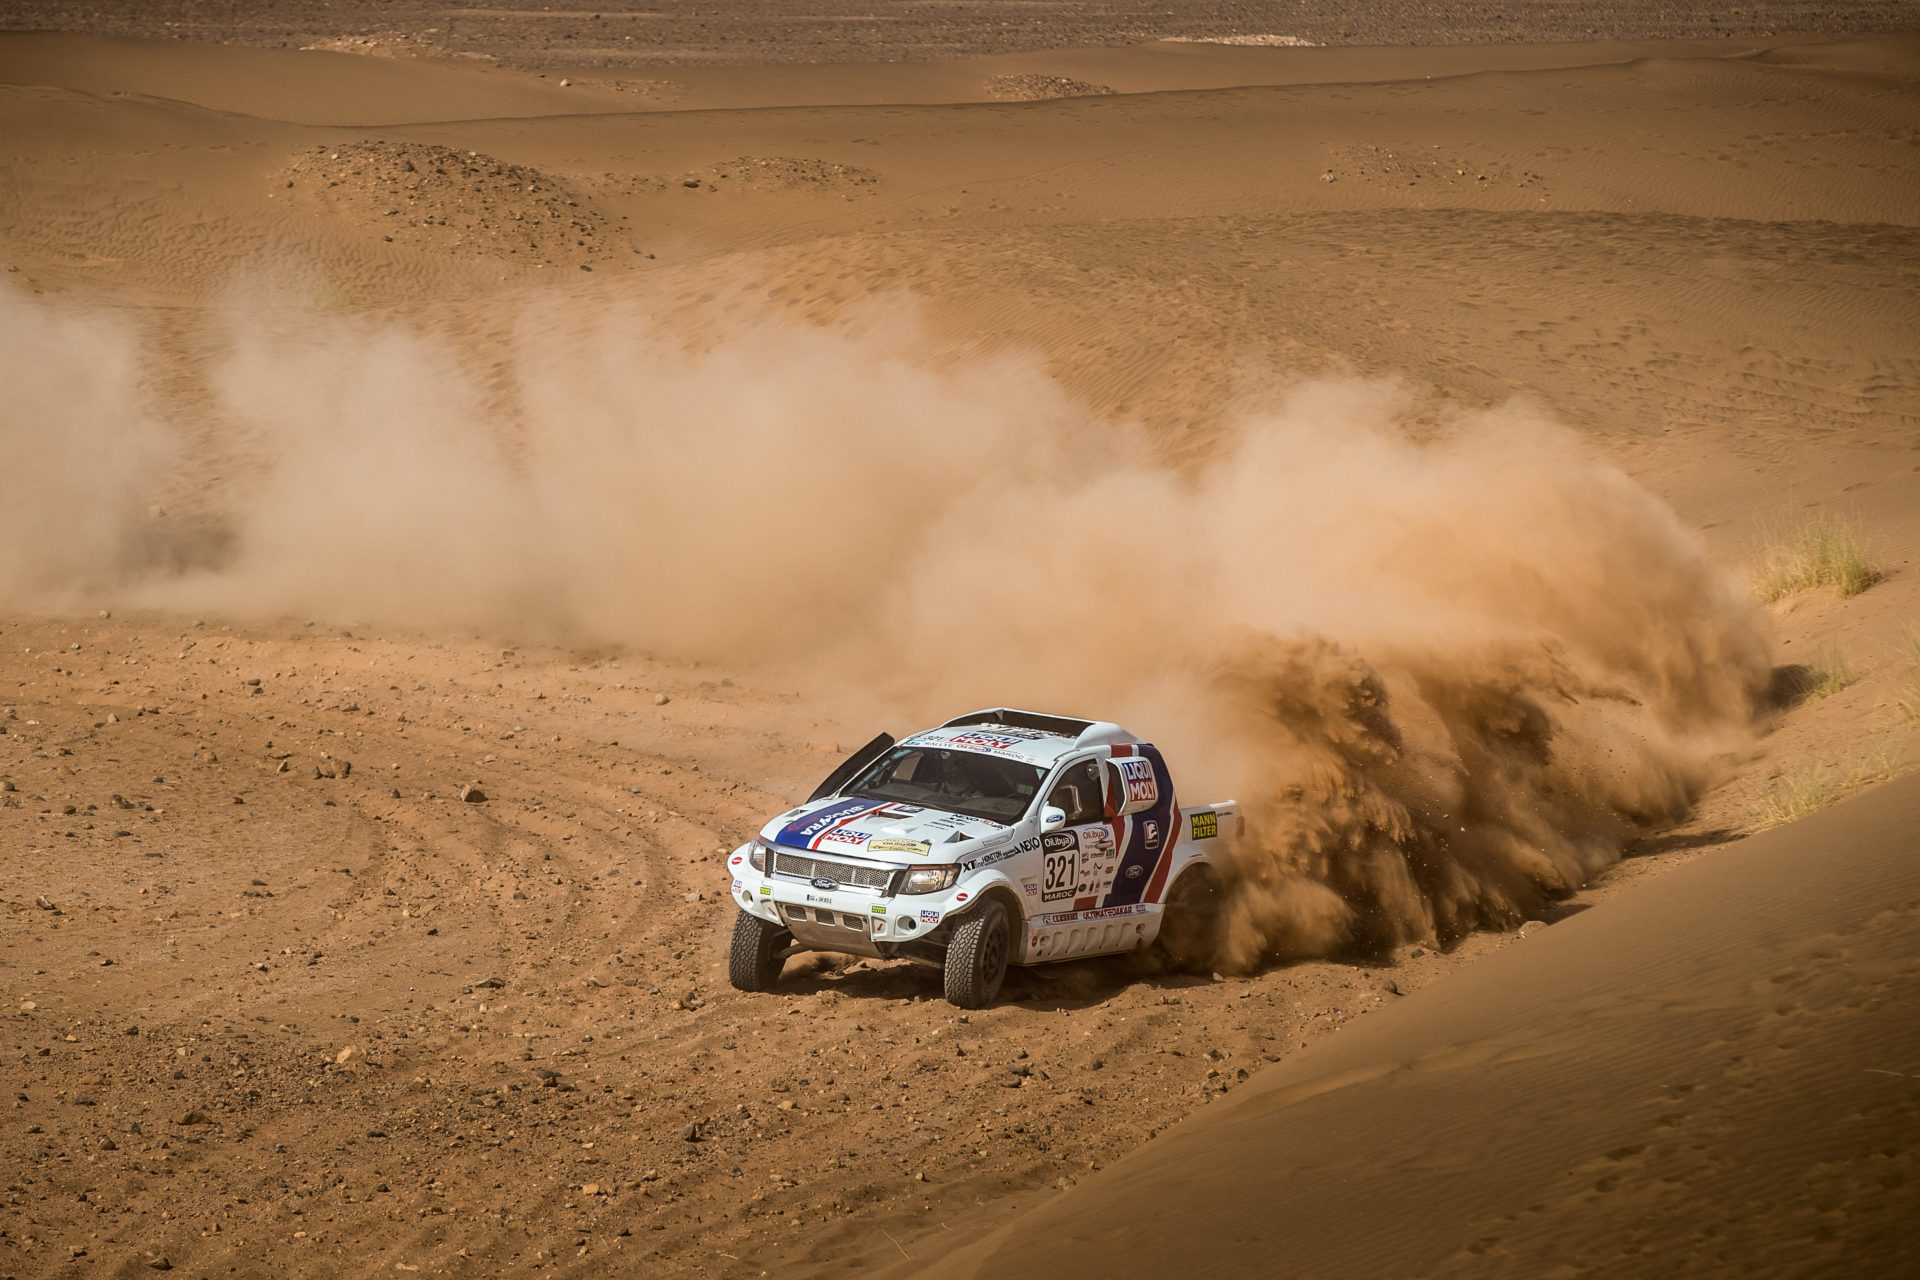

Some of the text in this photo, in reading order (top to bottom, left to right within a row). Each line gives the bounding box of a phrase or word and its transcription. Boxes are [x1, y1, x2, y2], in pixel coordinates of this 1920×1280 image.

[954, 737, 1012, 749] MOLY
[993, 750, 1024, 760] MAROC
[1124, 761, 1153, 780] LIQUI
[1129, 781, 1156, 801] MOLY
[1192, 813, 1216, 827] MANN
[831, 829, 871, 839] LIQUI
[1083, 829, 1105, 840] OiLibya
[1193, 825, 1217, 839] FILTER
[825, 834, 866, 844] MOLY
[1044, 836, 1070, 847] OiLibya
[1045, 853, 1076, 890] 321
[814, 879, 836, 888] Ford
[1044, 890, 1073, 901] MAROC
